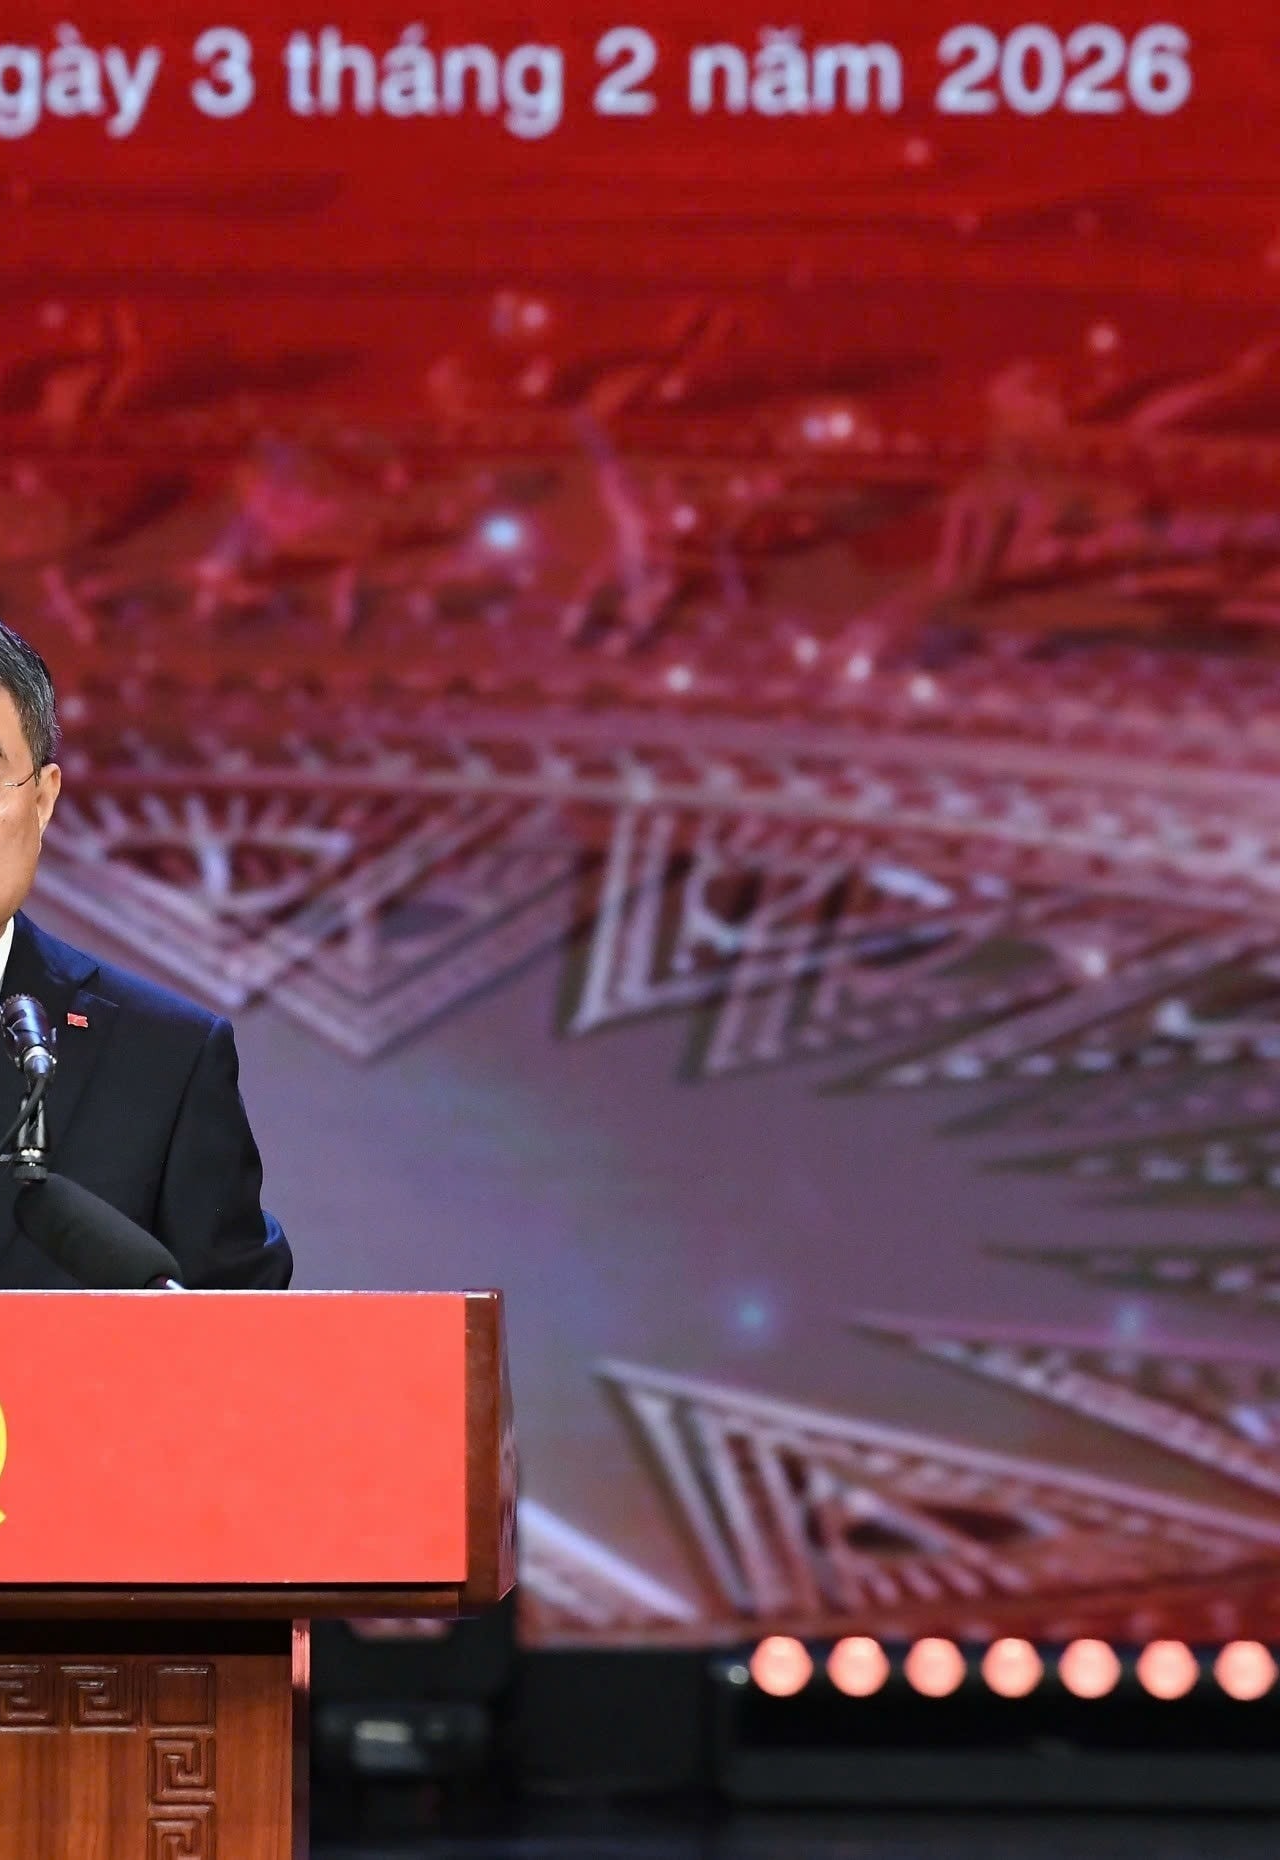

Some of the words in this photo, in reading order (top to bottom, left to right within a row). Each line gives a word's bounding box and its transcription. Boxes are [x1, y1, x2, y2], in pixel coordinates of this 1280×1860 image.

[192, 27, 254, 117] 3
[286, 25, 563, 137] tháng
[594, 27, 657, 115] 2
[690, 27, 901, 115] năm
[937, 24, 1191, 116] 2026
